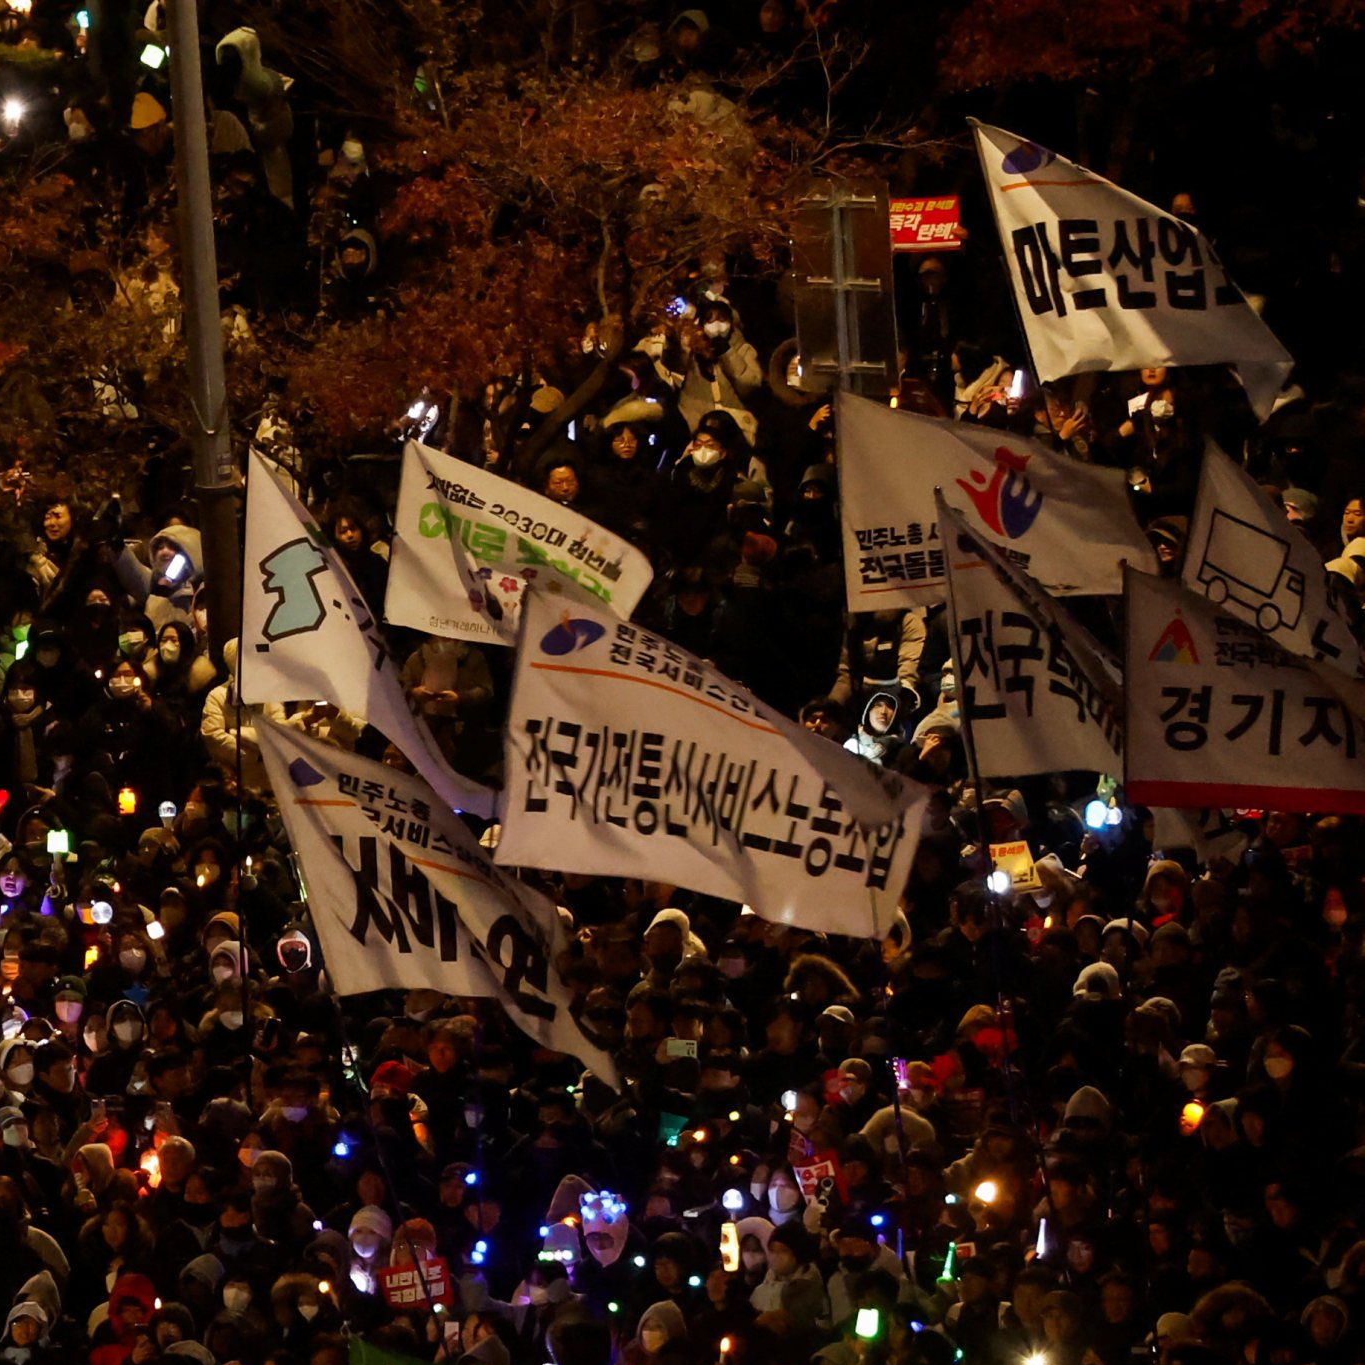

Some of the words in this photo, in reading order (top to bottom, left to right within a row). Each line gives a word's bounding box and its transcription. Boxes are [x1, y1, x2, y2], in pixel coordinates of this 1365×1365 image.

[1011, 216, 1247, 318] 마트산업
[489, 504, 567, 548] 2030대
[855, 522, 923, 553] 민주노총
[1158, 683, 1362, 759] 경기지
[338, 772, 431, 821] 민주노총
